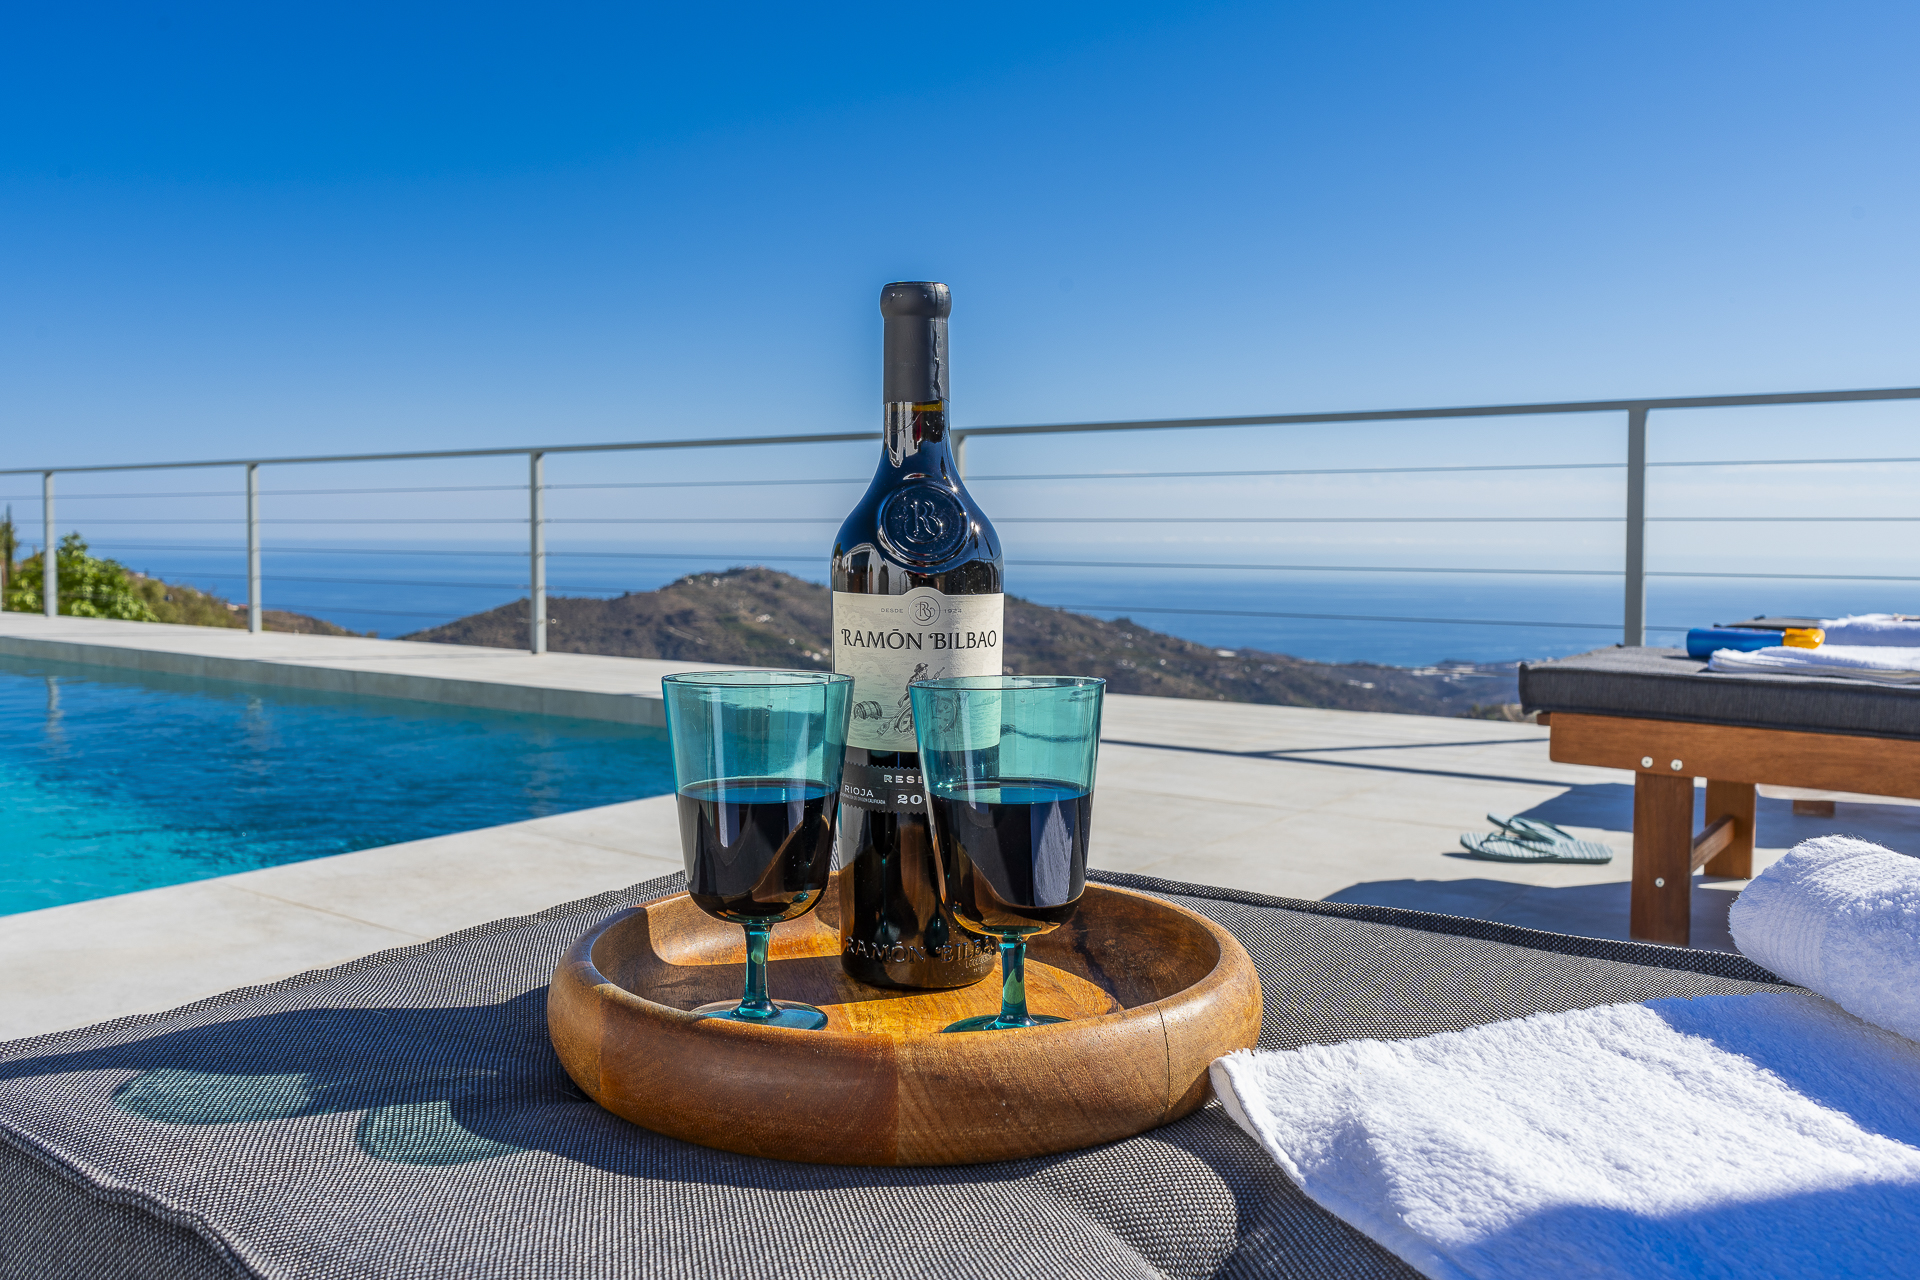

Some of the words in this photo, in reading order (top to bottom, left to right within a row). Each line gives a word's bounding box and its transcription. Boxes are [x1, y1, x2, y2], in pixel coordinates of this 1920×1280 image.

[929, 630, 997, 650] BILBAO
[883, 774, 923, 784] RESE
[844, 784, 874, 798] RIOJA
[897, 794, 922, 805] 20
[936, 936, 994, 963] BILBA
